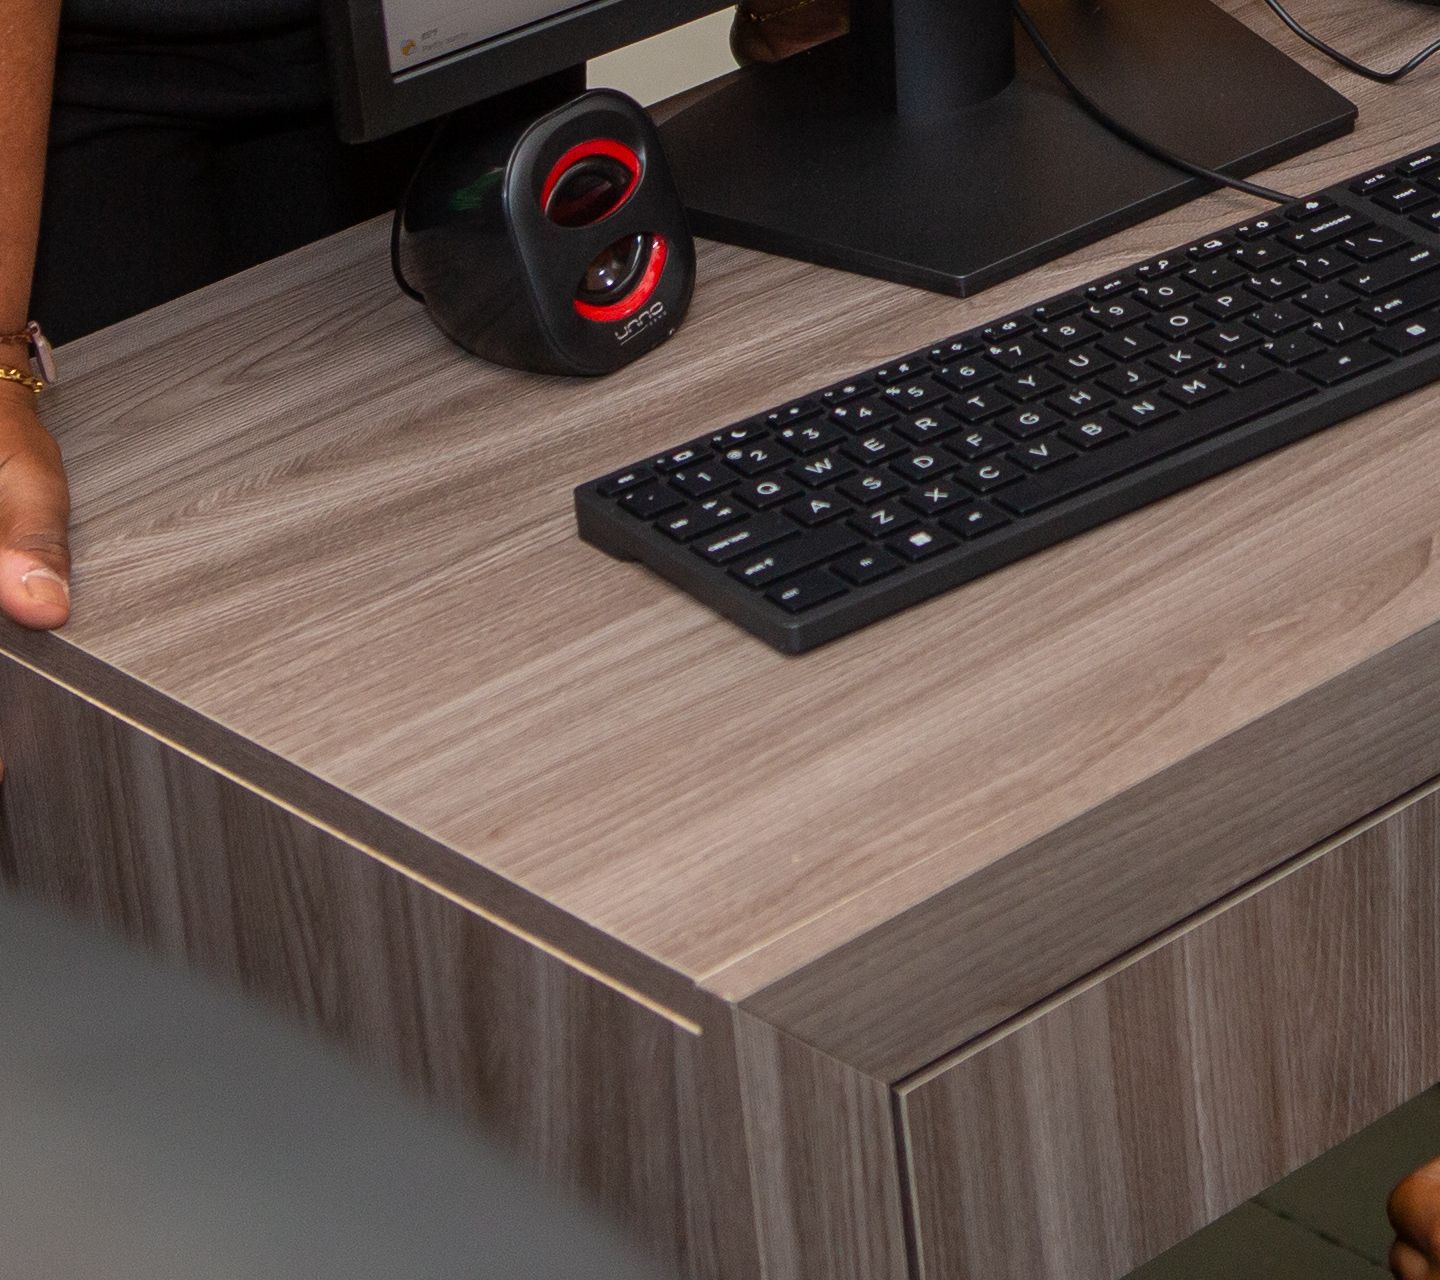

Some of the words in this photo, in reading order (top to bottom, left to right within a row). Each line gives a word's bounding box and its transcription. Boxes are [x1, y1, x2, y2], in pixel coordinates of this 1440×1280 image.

[697, 472, 711, 482] 1
[750, 450, 767, 462] 2
[802, 428, 820, 440] 3
[859, 407, 872, 418] 4
[907, 386, 924, 398] 5
[959, 366, 976, 377] 6
[1008, 345, 1022, 356] 7
[1059, 326, 1076, 336] 8
[1108, 306, 1124, 316] 9
[1158, 286, 1174, 296] 0
[756, 482, 780, 495] Q
[804, 458, 833, 474] W
[863, 438, 886, 452] E
[914, 417, 937, 431] R
[967, 396, 985, 407] T
[1017, 375, 1036, 387] Y
[1068, 354, 1089, 367] U
[1123, 336, 1137, 346] I
[1169, 315, 1189, 327] O
[1217, 295, 1233, 307] P
[810, 500, 830, 514] A
[862, 477, 882, 490] S
[912, 455, 934, 469] D
[966, 433, 982, 447] F
[1019, 412, 1040, 425] G
[1069, 391, 1091, 405] H
[1127, 371, 1139, 383] J
[1169, 350, 1192, 363] K
[1219, 333, 1240, 342] L
[871, 510, 894, 525] Z
[924, 487, 948, 502] X
[979, 466, 1000, 479] C
[1028, 444, 1048, 456] V
[1081, 423, 1103, 436] B
[1132, 401, 1155, 415] N
[1182, 379, 1206, 394] M
